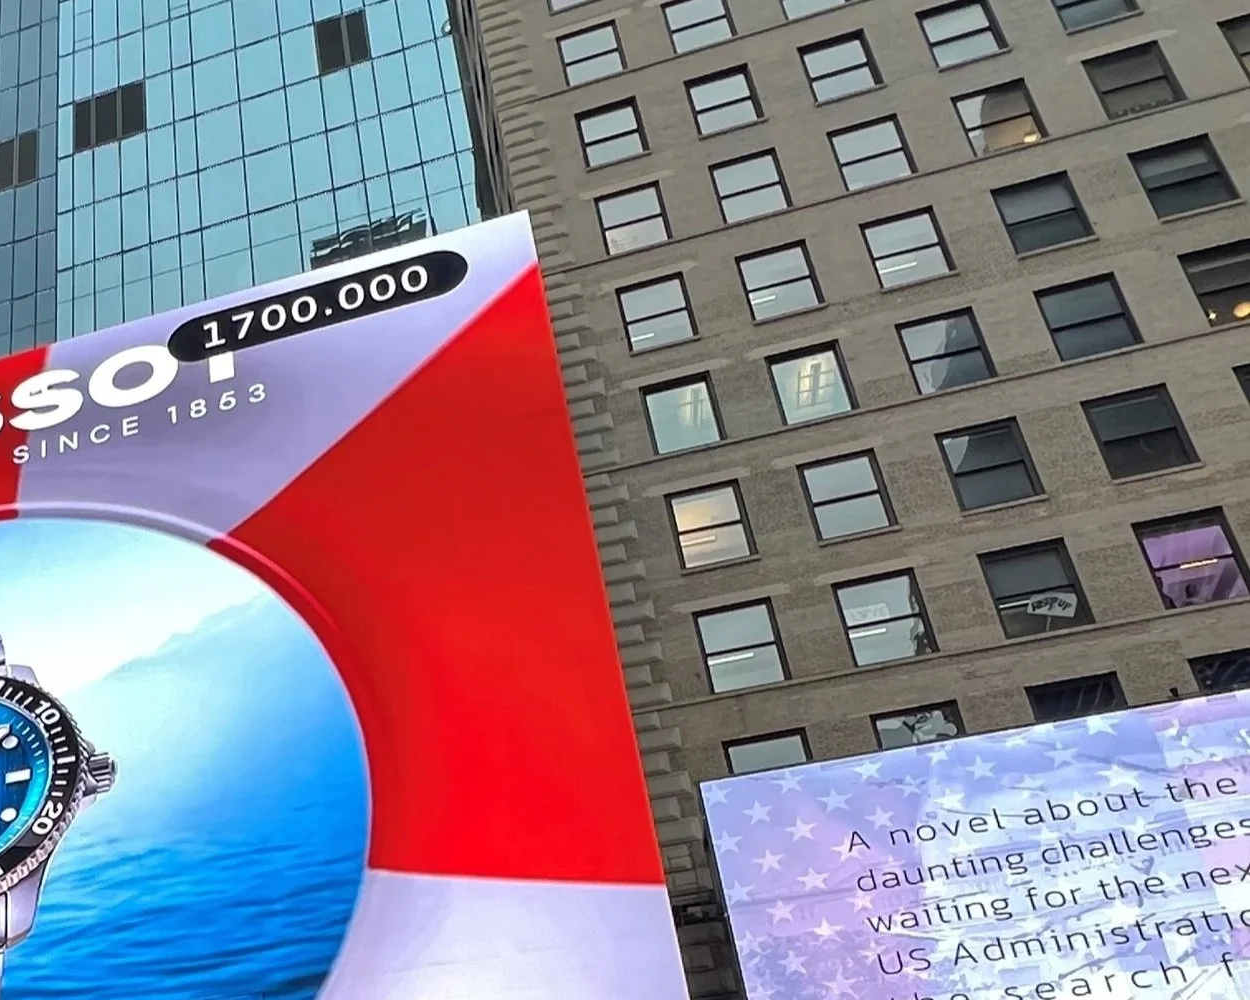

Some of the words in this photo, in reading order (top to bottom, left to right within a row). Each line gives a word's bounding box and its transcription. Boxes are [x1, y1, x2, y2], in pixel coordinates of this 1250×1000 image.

[203, 265, 429, 349] 1700.000
[12, 415, 140, 465] SINCE
[166, 383, 267, 425] 1853
[36, 699, 61, 726] 10
[31, 800, 65, 836] 20
[848, 829, 871, 854] A
[887, 808, 1006, 847] novel
[1022, 787, 1150, 827] about
[1165, 772, 1240, 802] the
[855, 848, 1030, 894] daunting
[864, 893, 1013, 935] waiting
[1026, 886, 1084, 913] for
[1097, 873, 1166, 902] the
[875, 948, 934, 976] US
